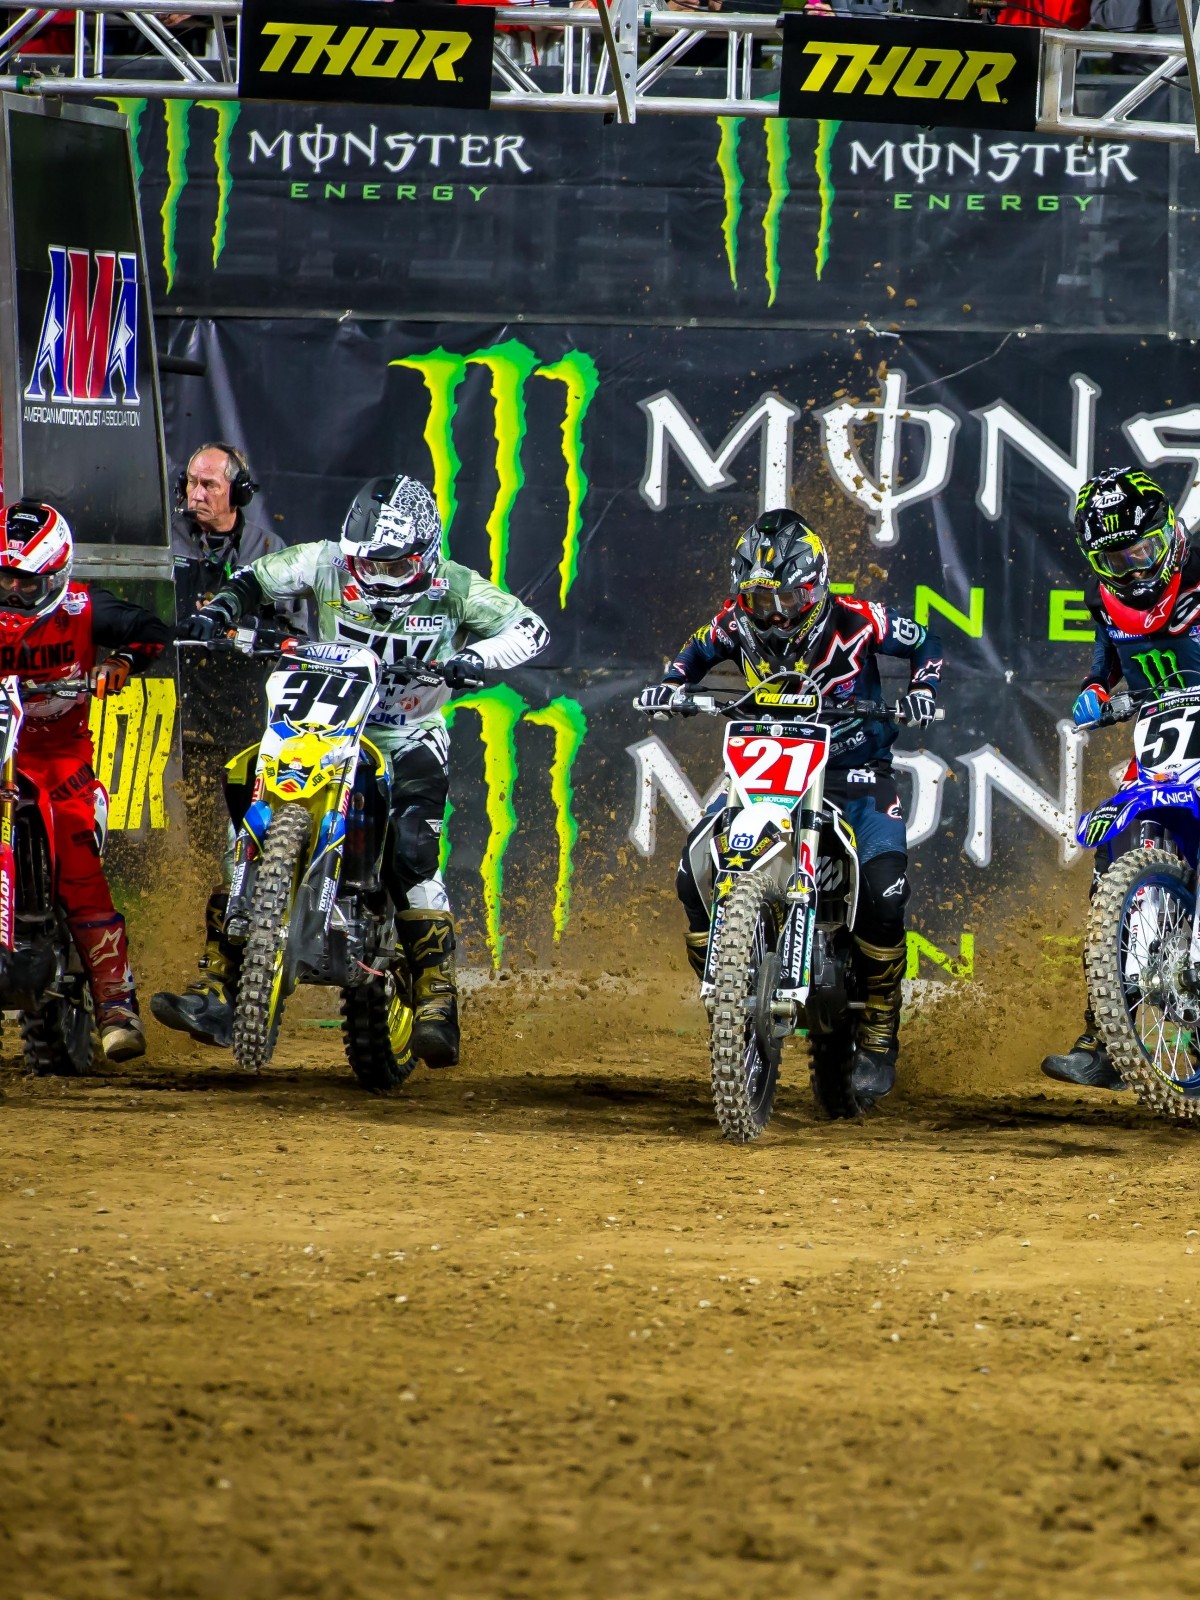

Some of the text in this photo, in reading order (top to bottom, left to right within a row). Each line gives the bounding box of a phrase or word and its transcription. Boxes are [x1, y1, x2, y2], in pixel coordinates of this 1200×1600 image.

[260, 22, 472, 82] THOR
[800, 41, 1017, 103] THOR
[248, 123, 533, 173] MONSTER
[849, 133, 1138, 183] MONSTER
[290, 183, 488, 202] ENERGY
[894, 193, 1095, 212] ENERGY
[24, 244, 140, 406] AMA
[23, 406, 140, 427] AMERICAN MOTORCYCLIST ASSOCIATION
[1091, 529, 1138, 549] MONSTER
[0, 641, 75, 671] RACING
[450, 653, 484, 667] FLY
[270, 672, 370, 726] 34
[1165, 696, 1200, 707] MONSTER
[743, 738, 815, 792] 21
[763, 795, 795, 804] MOTOREX
[1151, 789, 1194, 806] KNICH
[0, 870, 10, 946] DUNLOP
[318, 876, 331, 912] TEXTRON
[782, 913, 793, 967] SCOSC
[791, 907, 807, 983] DUNLOP
